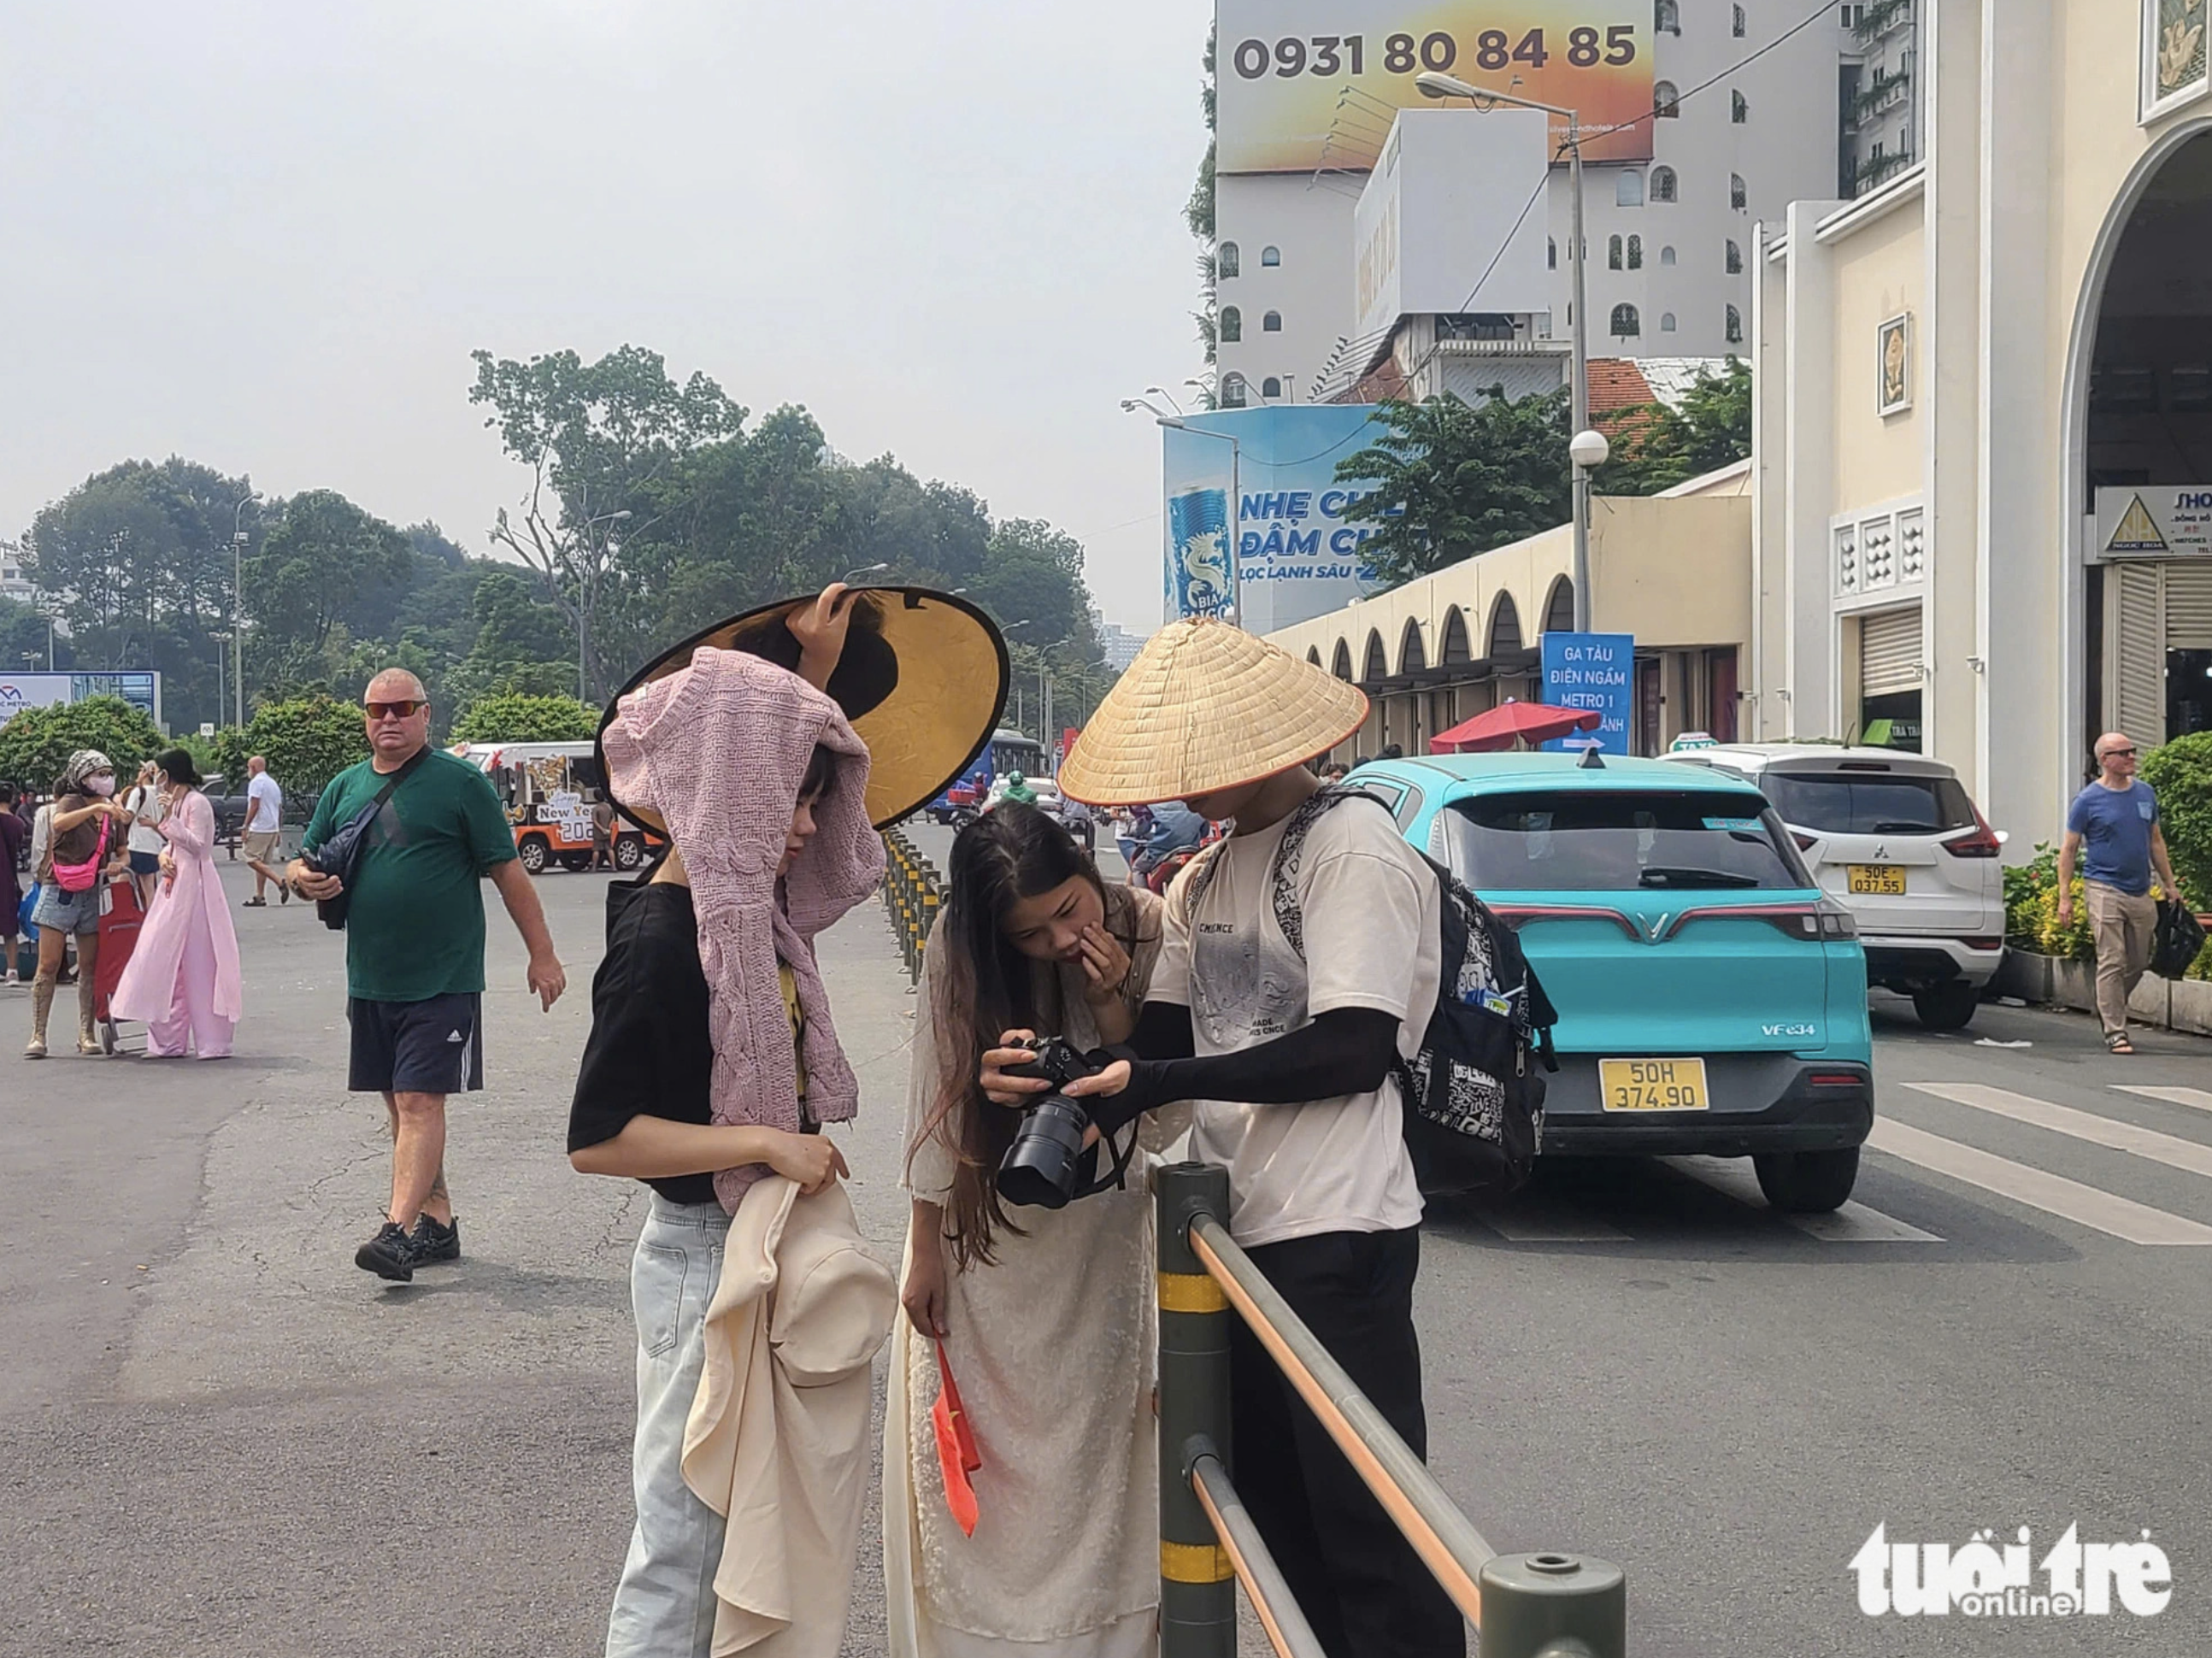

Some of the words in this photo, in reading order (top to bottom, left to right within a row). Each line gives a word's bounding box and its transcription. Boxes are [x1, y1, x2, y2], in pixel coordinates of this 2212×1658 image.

[1233, 35, 1364, 79] 0931
[1383, 32, 1456, 74] 80
[1475, 28, 1549, 71] 84
[1567, 25, 1637, 68] 85
[1239, 491, 1312, 526] NHẸ
[1239, 522, 1321, 564] ĐẬM
[1268, 566, 1313, 582] LẠNH
[1315, 562, 1351, 579] SÂU
[1198, 593, 1219, 609] BIA
[1564, 647, 1583, 661] GA
[1585, 644, 1613, 661] TÀU
[1550, 667, 1581, 687] ĐIỆN
[1561, 693, 1604, 708] METRO
[1609, 694, 1614, 708] 1
[539, 807, 570, 819] New
[1865, 866, 1890, 879] 50E
[1855, 879, 1899, 892] 037.55
[1630, 1062, 1675, 1084] 50H
[1615, 1086, 1696, 1108] 374.90
